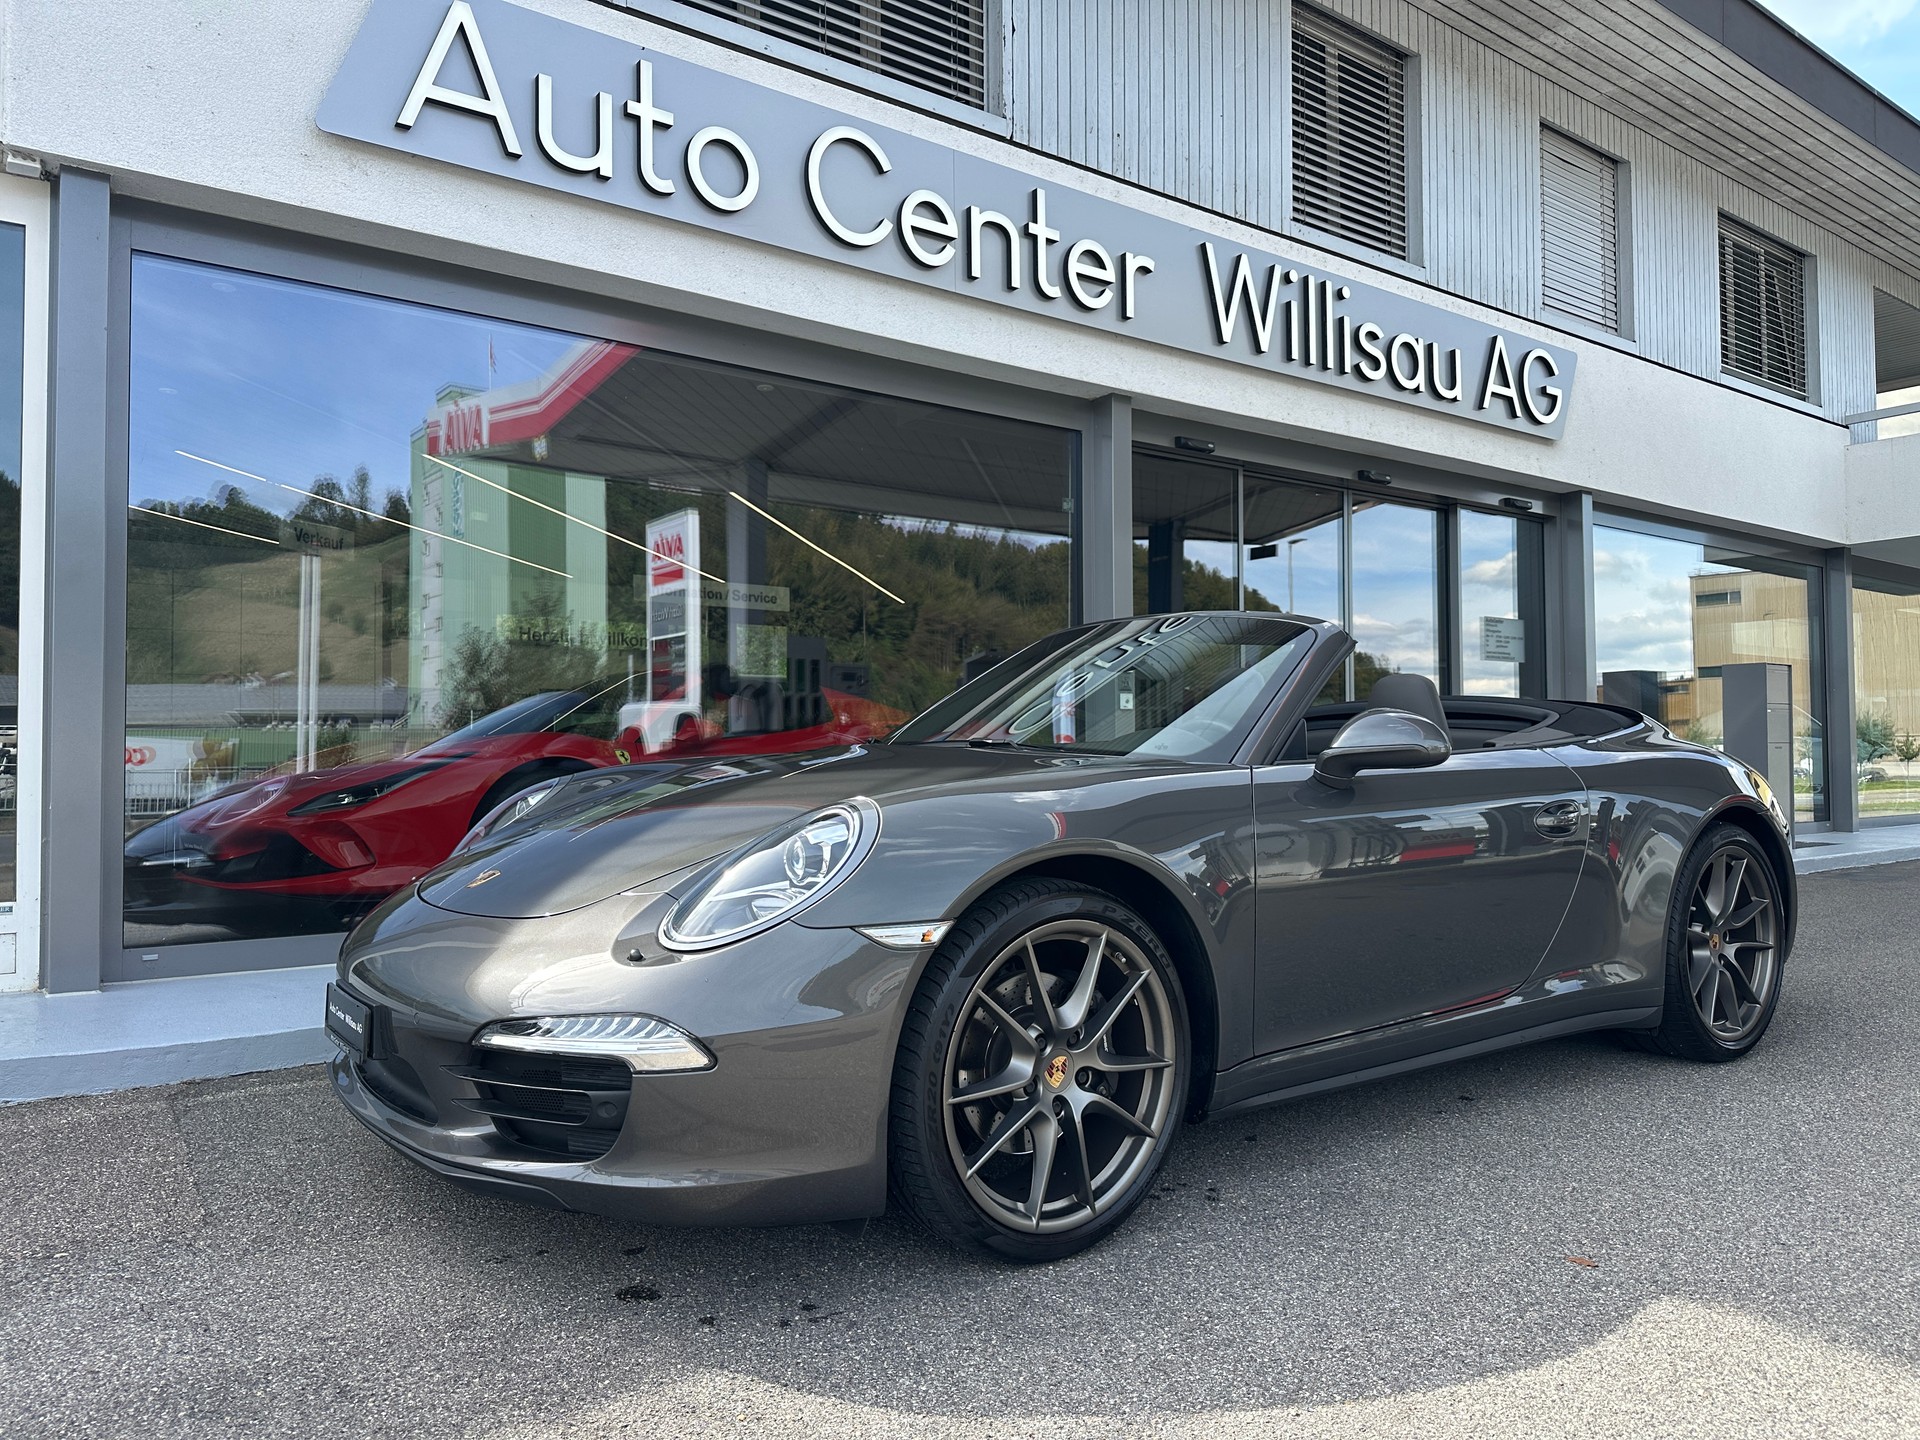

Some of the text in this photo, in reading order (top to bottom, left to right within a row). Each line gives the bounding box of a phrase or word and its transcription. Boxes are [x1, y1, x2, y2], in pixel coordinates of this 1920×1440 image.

[395, 0, 1563, 425] Auto Center Willisau AG
[294, 527, 344, 550] Verkauf
[732, 589, 778, 605] Service
[1120, 913, 1171, 969] ZERO
